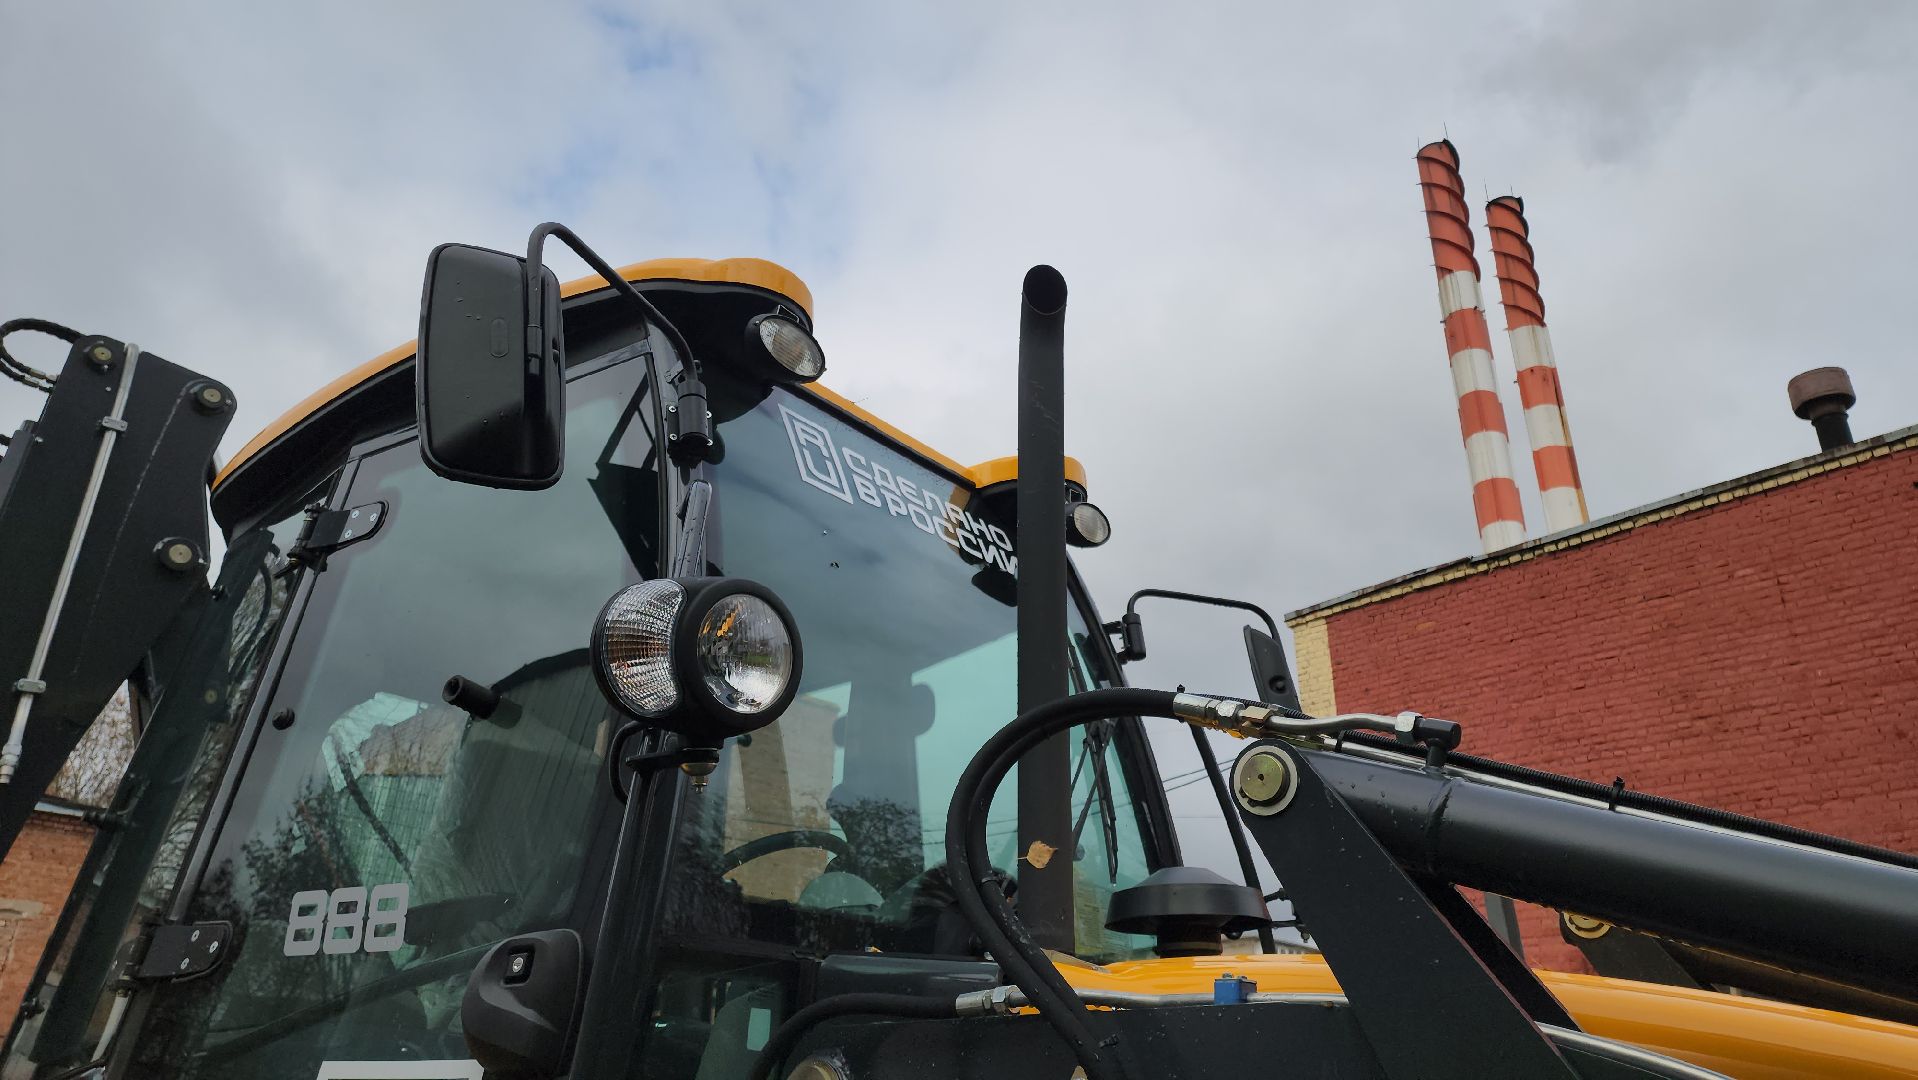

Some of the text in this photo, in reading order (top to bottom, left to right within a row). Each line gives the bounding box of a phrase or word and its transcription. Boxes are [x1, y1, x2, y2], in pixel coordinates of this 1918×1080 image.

[843, 447, 1014, 552] СДЕЛАНО
[853, 474, 1018, 580] В РОССИИ
[283, 883, 409, 957] 888
